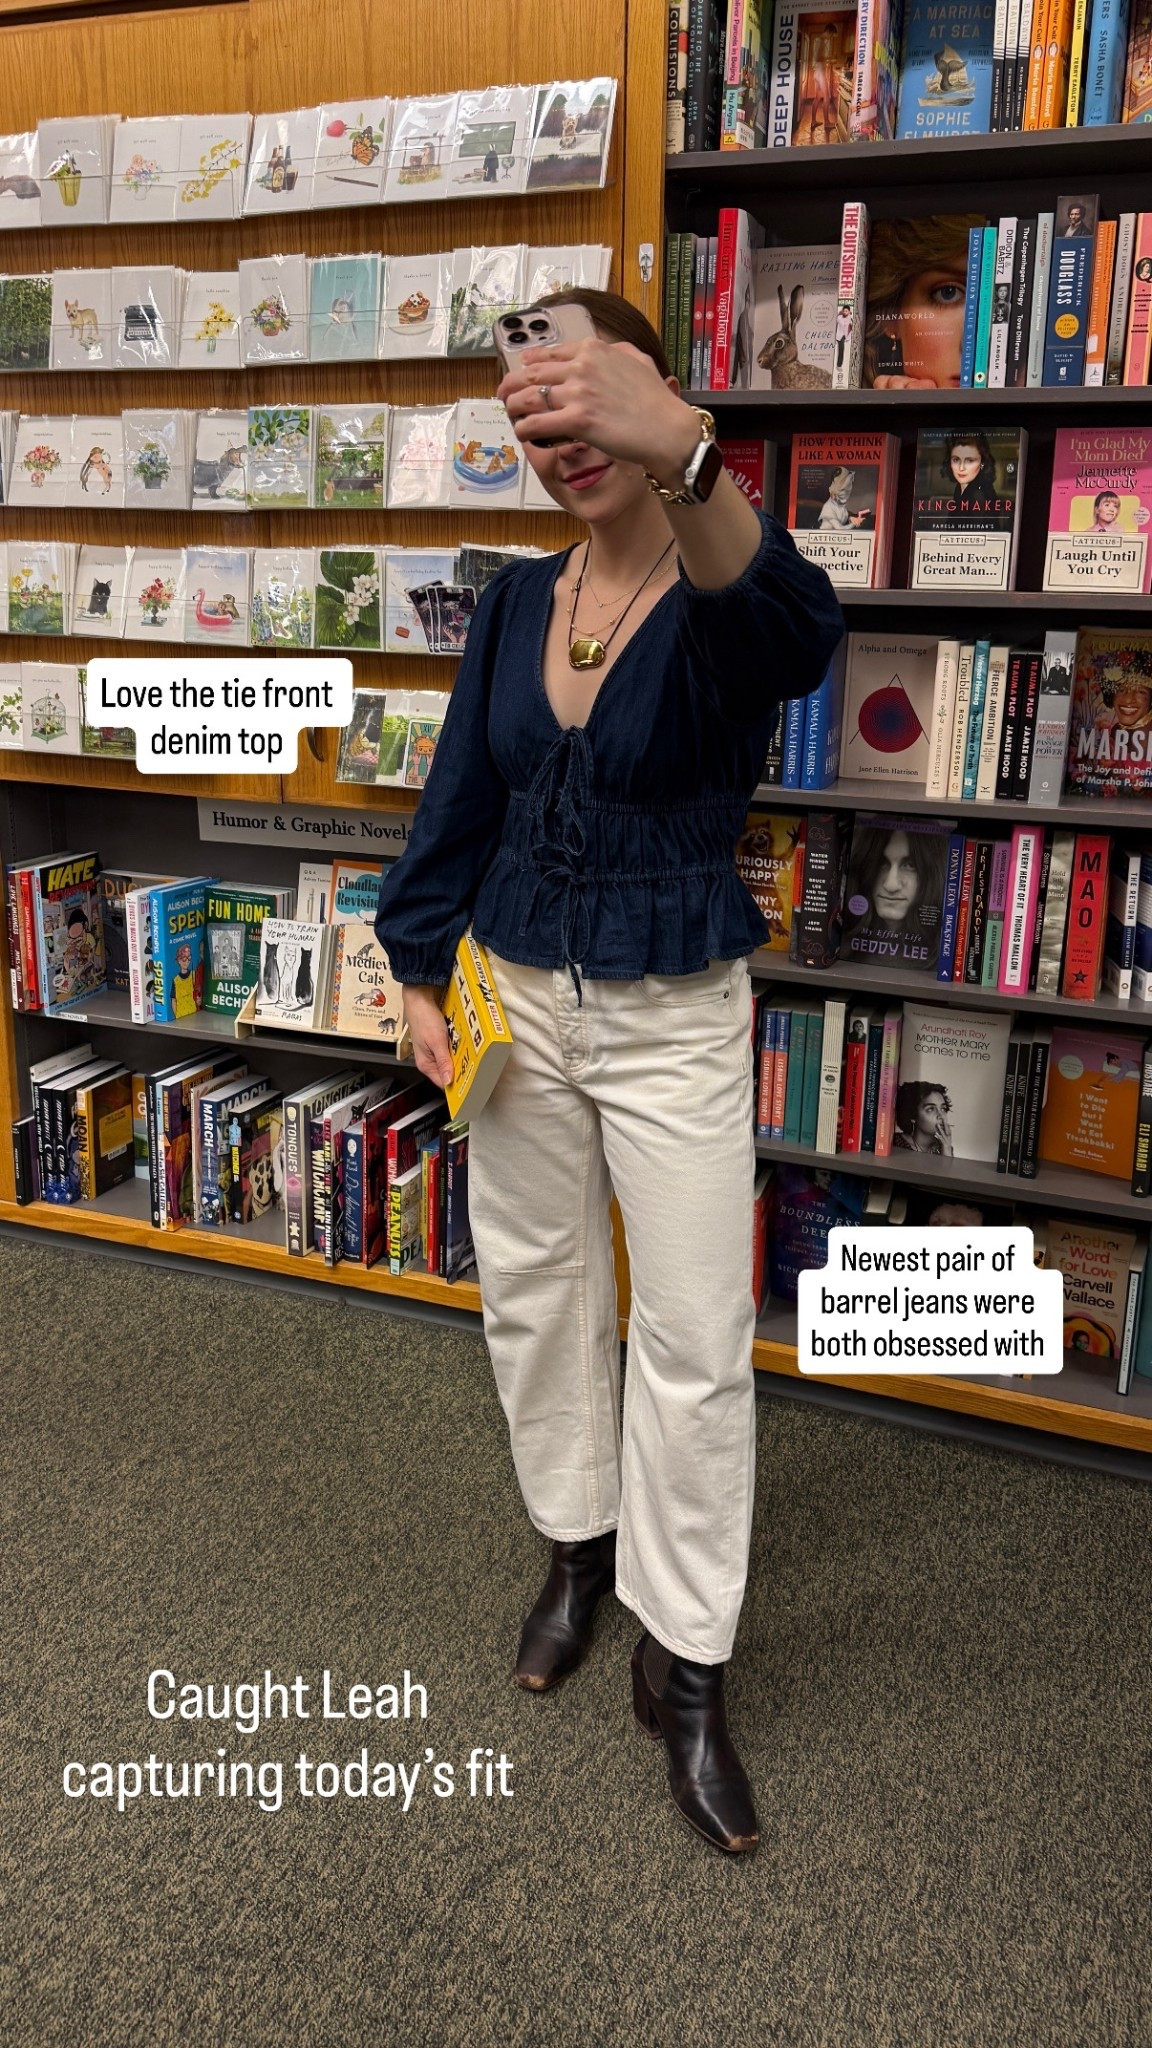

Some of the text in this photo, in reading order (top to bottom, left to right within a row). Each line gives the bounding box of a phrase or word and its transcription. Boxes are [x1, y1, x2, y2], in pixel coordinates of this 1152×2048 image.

[928, 24, 981, 39] AT SEA
[997, 6, 1005, 46] BALDWIN
[1008, 5, 1017, 45] BALDWIN
[1020, 3, 1030, 43] BALDWIN
[668, 10, 680, 98] COLLISIONS
[1094, 30, 1108, 97] SASHA BONÉT
[773, 15, 794, 148] DEEP HOUSE
[916, 112, 972, 126] SOPHIE
[840, 205, 860, 290] THE OUTSIDER
[760, 259, 840, 274] RAISING HARE
[997, 245, 1006, 275] BABITZ
[1056, 250, 1076, 305] DOUGLASS
[1075, 247, 1086, 307] FREDERICK
[964, 233, 980, 370] JOAN DIDION NIGHTS
[1013, 227, 1030, 361] The Copenhagen Trilogy Tove Ditlevsen
[875, 312, 935, 321] DIANAWORLD
[801, 341, 836, 351] DALTON
[805, 331, 833, 340] CHLOE
[798, 436, 883, 447] HOW TO THINK
[1070, 437, 1151, 452] I'm Glad My
[798, 450, 881, 461] LIKE A WOMAN
[1075, 450, 1144, 462] Mom Died
[1077, 465, 1137, 479] Jennette
[1075, 477, 1138, 491] McCurdy
[918, 499, 1013, 512] KINGMAKER
[798, 546, 861, 558] Shift Your
[922, 553, 1002, 565] Behind Every
[1055, 550, 1137, 562] Laugh Until
[923, 565, 997, 576] Great Man...
[1067, 564, 1122, 577] You Cry
[858, 645, 881, 654] Alpha
[900, 646, 927, 656] Omega
[957, 655, 971, 702] Troubled
[986, 670, 1000, 740] FIERCE AMBITION
[1001, 660, 1020, 778] TRAUMA PLOT JAMIE HOOD
[1018, 661, 1038, 780] TRAUMA PLOT JAMIE HOOD
[787, 700, 799, 775] KAMALA HARRIS
[807, 700, 820, 775] KAMALA HARRIS
[1077, 728, 1152, 761] MARS
[953, 728, 963, 777] HENDERSON
[891, 767, 919, 776] Harrison
[1078, 764, 1131, 776] The Joy and
[1088, 776, 1121, 786] Marsha
[212, 811, 413, 840] Humor & Graphic Novel
[1023, 839, 1031, 851] THE
[736, 855, 792, 870] URIOUSLY
[1021, 853, 1030, 869] VERY
[48, 857, 96, 892] HATE
[741, 868, 780, 882] HAPPY
[1018, 871, 1028, 892] HEART
[973, 846, 987, 933] PRIESTDADDY
[1017, 893, 1025, 901] OF
[1078, 851, 1100, 928] MAO
[1127, 873, 1138, 920] THE RETURN
[167, 899, 190, 912] ALISON
[208, 899, 272, 923] FUN HOME
[943, 849, 960, 956] DONNA LEON BACKSTAGE
[876, 929, 922, 942] Effin' Life
[1013, 915, 1023, 942] THOMAS
[851, 938, 928, 960] GEDDY LEE
[1010, 944, 1020, 970] MALLON
[153, 961, 164, 1005] SPENT
[358, 971, 385, 987] Cats
[476, 961, 487, 984] ASAKO
[489, 1005, 503, 1033] BUTTER
[920, 1023, 987, 1040] Arundhati Roy
[762, 1057, 770, 1081] LESBIAN
[775, 1058, 783, 1082] LESBIAN
[78, 1115, 88, 1153] MOAN
[202, 1103, 213, 1147] MARCH
[1080, 1119, 1103, 1129] Want
[287, 1122, 298, 1172] TONGUES
[1136, 1123, 1150, 1172] ELI SHARABI
[390, 1192, 401, 1257] PEANUTS
[780, 1205, 861, 1227] BOUNDLESS
[1060, 1232, 1121, 1250] Another
[1069, 1246, 1110, 1264] Word
[1059, 1258, 1118, 1279] for Love
[1063, 1274, 1112, 1294] Carvell
